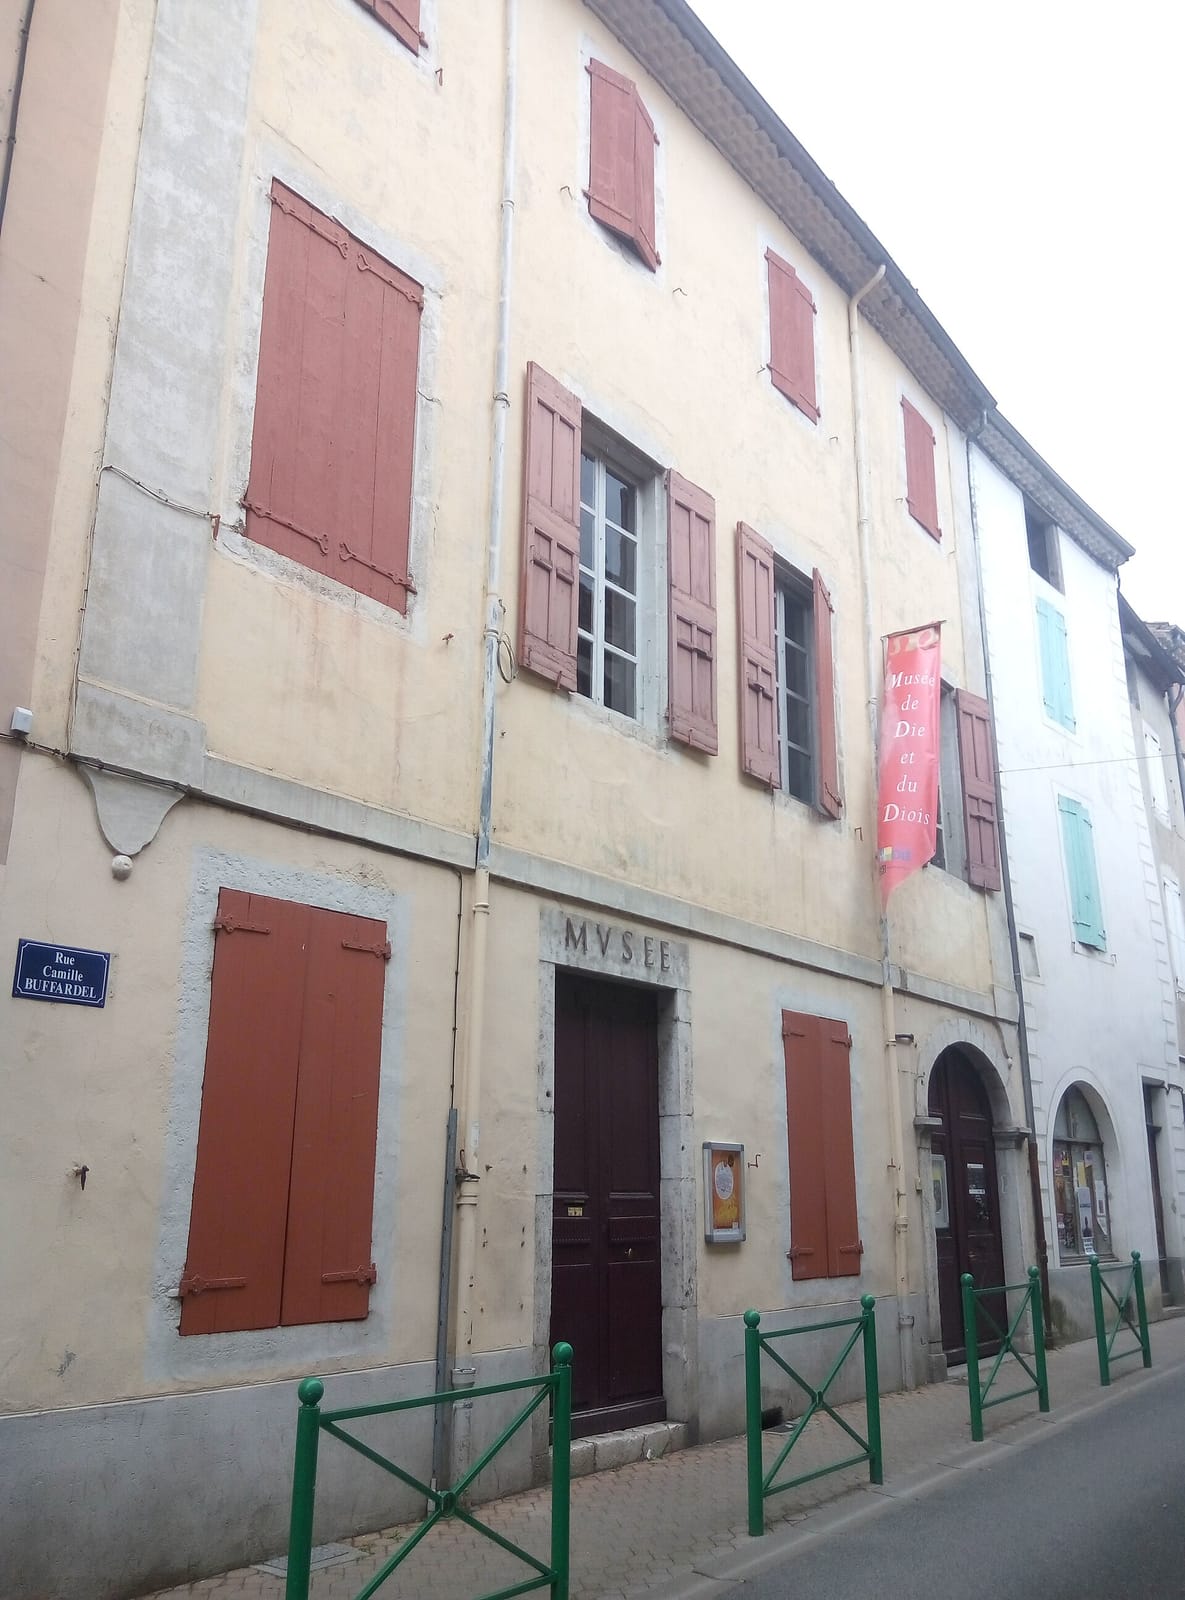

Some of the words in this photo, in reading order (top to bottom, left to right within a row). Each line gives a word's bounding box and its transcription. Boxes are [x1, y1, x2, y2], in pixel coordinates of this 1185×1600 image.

[901, 694, 919, 711] de
[894, 720, 925, 738] Die
[900, 751, 915, 764] et
[896, 775, 918, 792] du
[883, 803, 930, 825] Diois
[565, 917, 670, 972] MVSEE
[55, 951, 75, 966] Rue
[42, 965, 84, 982] Camille
[24, 977, 97, 999] BUFFARDEL
